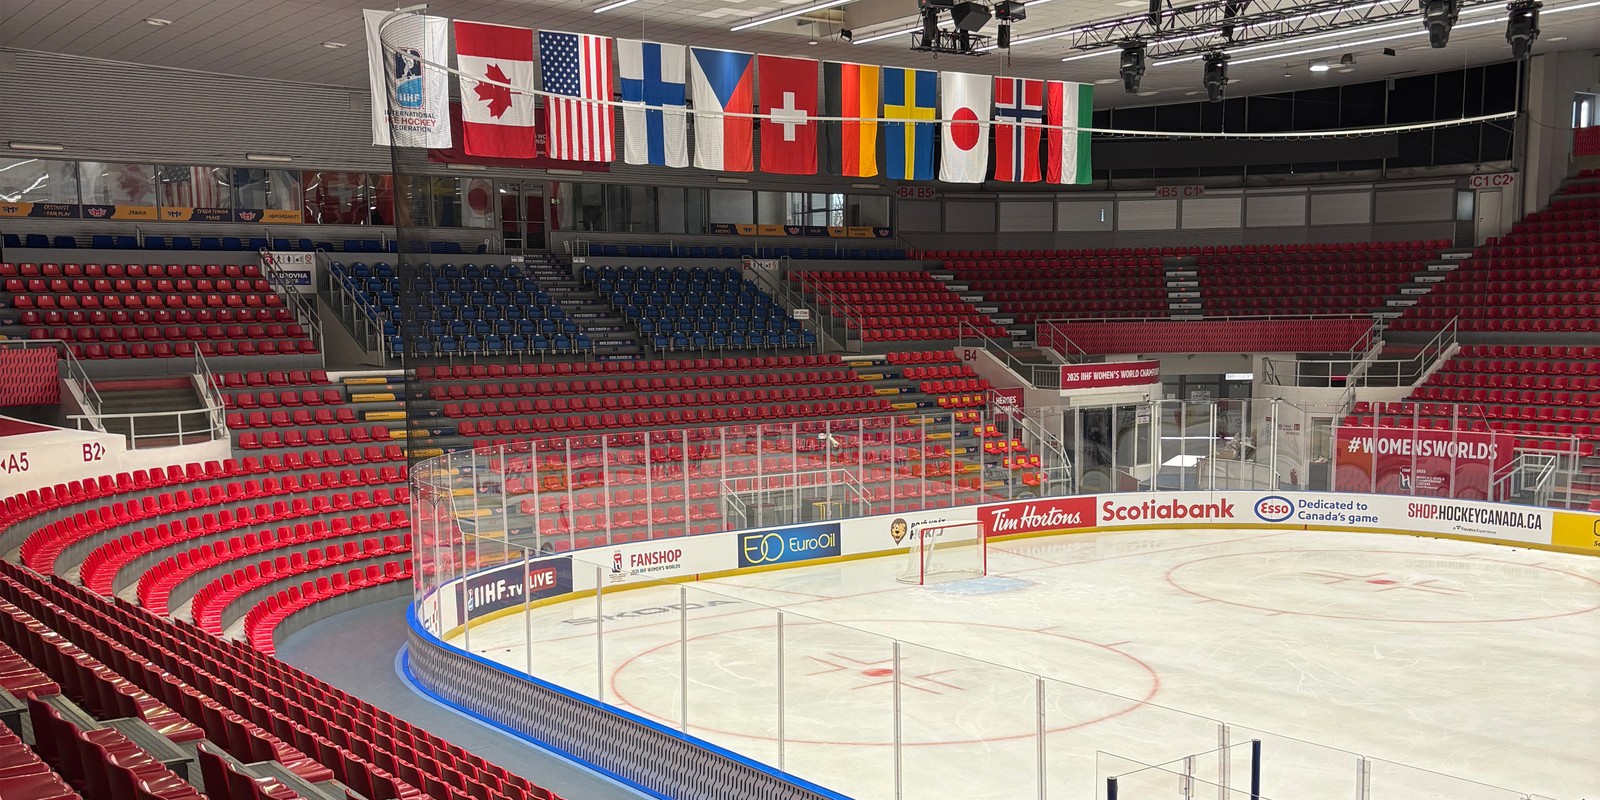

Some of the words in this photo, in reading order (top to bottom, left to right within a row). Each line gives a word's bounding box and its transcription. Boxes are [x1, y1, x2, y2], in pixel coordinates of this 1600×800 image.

[385, 110, 435, 118] ITERNATIONAL
[385, 116, 399, 124] IE
[401, 117, 436, 127] HOCKEY
[1473, 176, 1489, 187] C1
[1493, 174, 1509, 185] C2
[901, 187, 914, 197] B4
[917, 187, 931, 197] B5
[1161, 187, 1178, 197] B5
[1183, 186, 1199, 196] C1
[964, 350, 977, 361] B4
[1066, 372, 1080, 382] 2025
[1080, 371, 1092, 381] IIHF
[1093, 370, 1120, 380] WOMEN'S
[1120, 369, 1140, 379] WORLD
[82, 442, 102, 462] B2
[1348, 436, 1498, 460] #WOMENSWORLDS
[8, 451, 29, 474] A5
[1102, 498, 1235, 521] Scotiabank
[1260, 502, 1289, 514] Esso
[1298, 499, 1354, 511] Dedicated
[1356, 501, 1368, 511] to
[991, 506, 1018, 533] Tim
[1298, 511, 1346, 522] Canada's
[1348, 514, 1379, 524] game
[1408, 502, 1542, 531] SHOP.HOCKEYCANADA.CA
[789, 533, 836, 552] EuroOil
[630, 549, 682, 567] FANSHOP
[529, 571, 554, 589] LIVE
